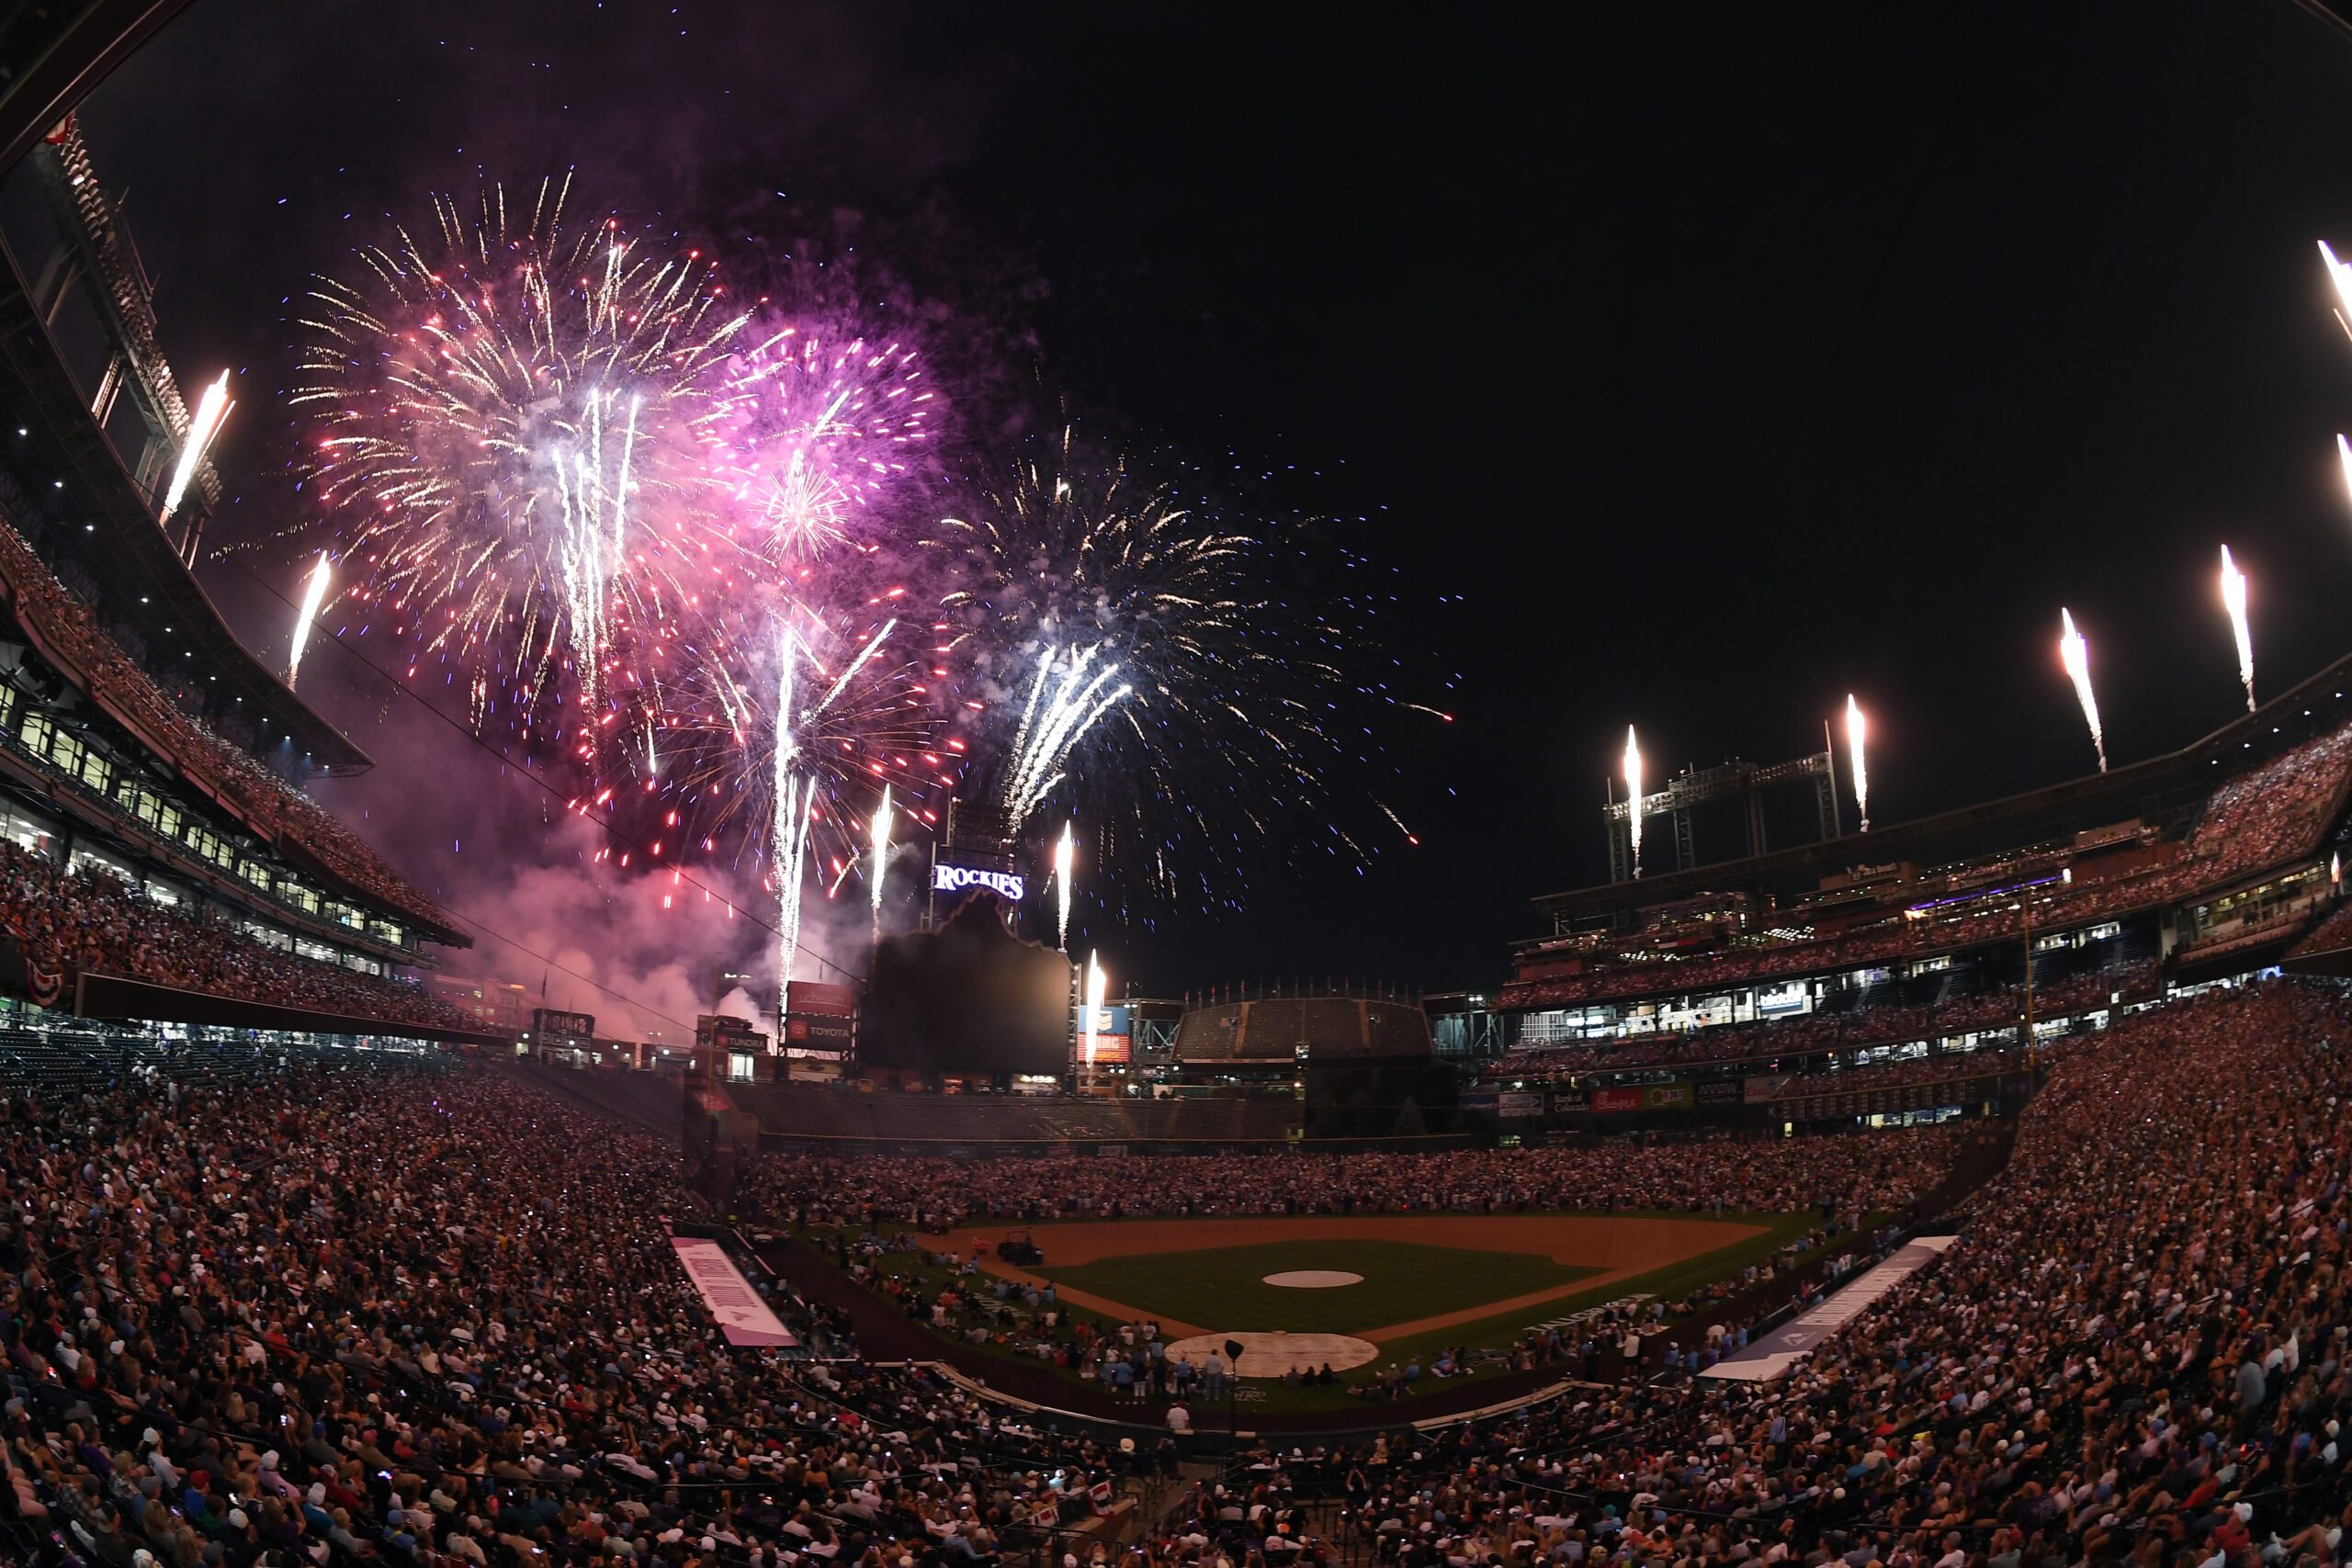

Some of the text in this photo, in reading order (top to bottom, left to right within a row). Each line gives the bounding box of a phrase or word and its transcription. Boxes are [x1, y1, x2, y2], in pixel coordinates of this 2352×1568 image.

[934, 864, 1023, 900] ROCKIES
[809, 1027, 850, 1037] TOYOTA
[729, 1038, 764, 1048] TUNDRA
[1554, 1092, 1584, 1103] Bank of
[1554, 1102, 1589, 1112] Colorado
